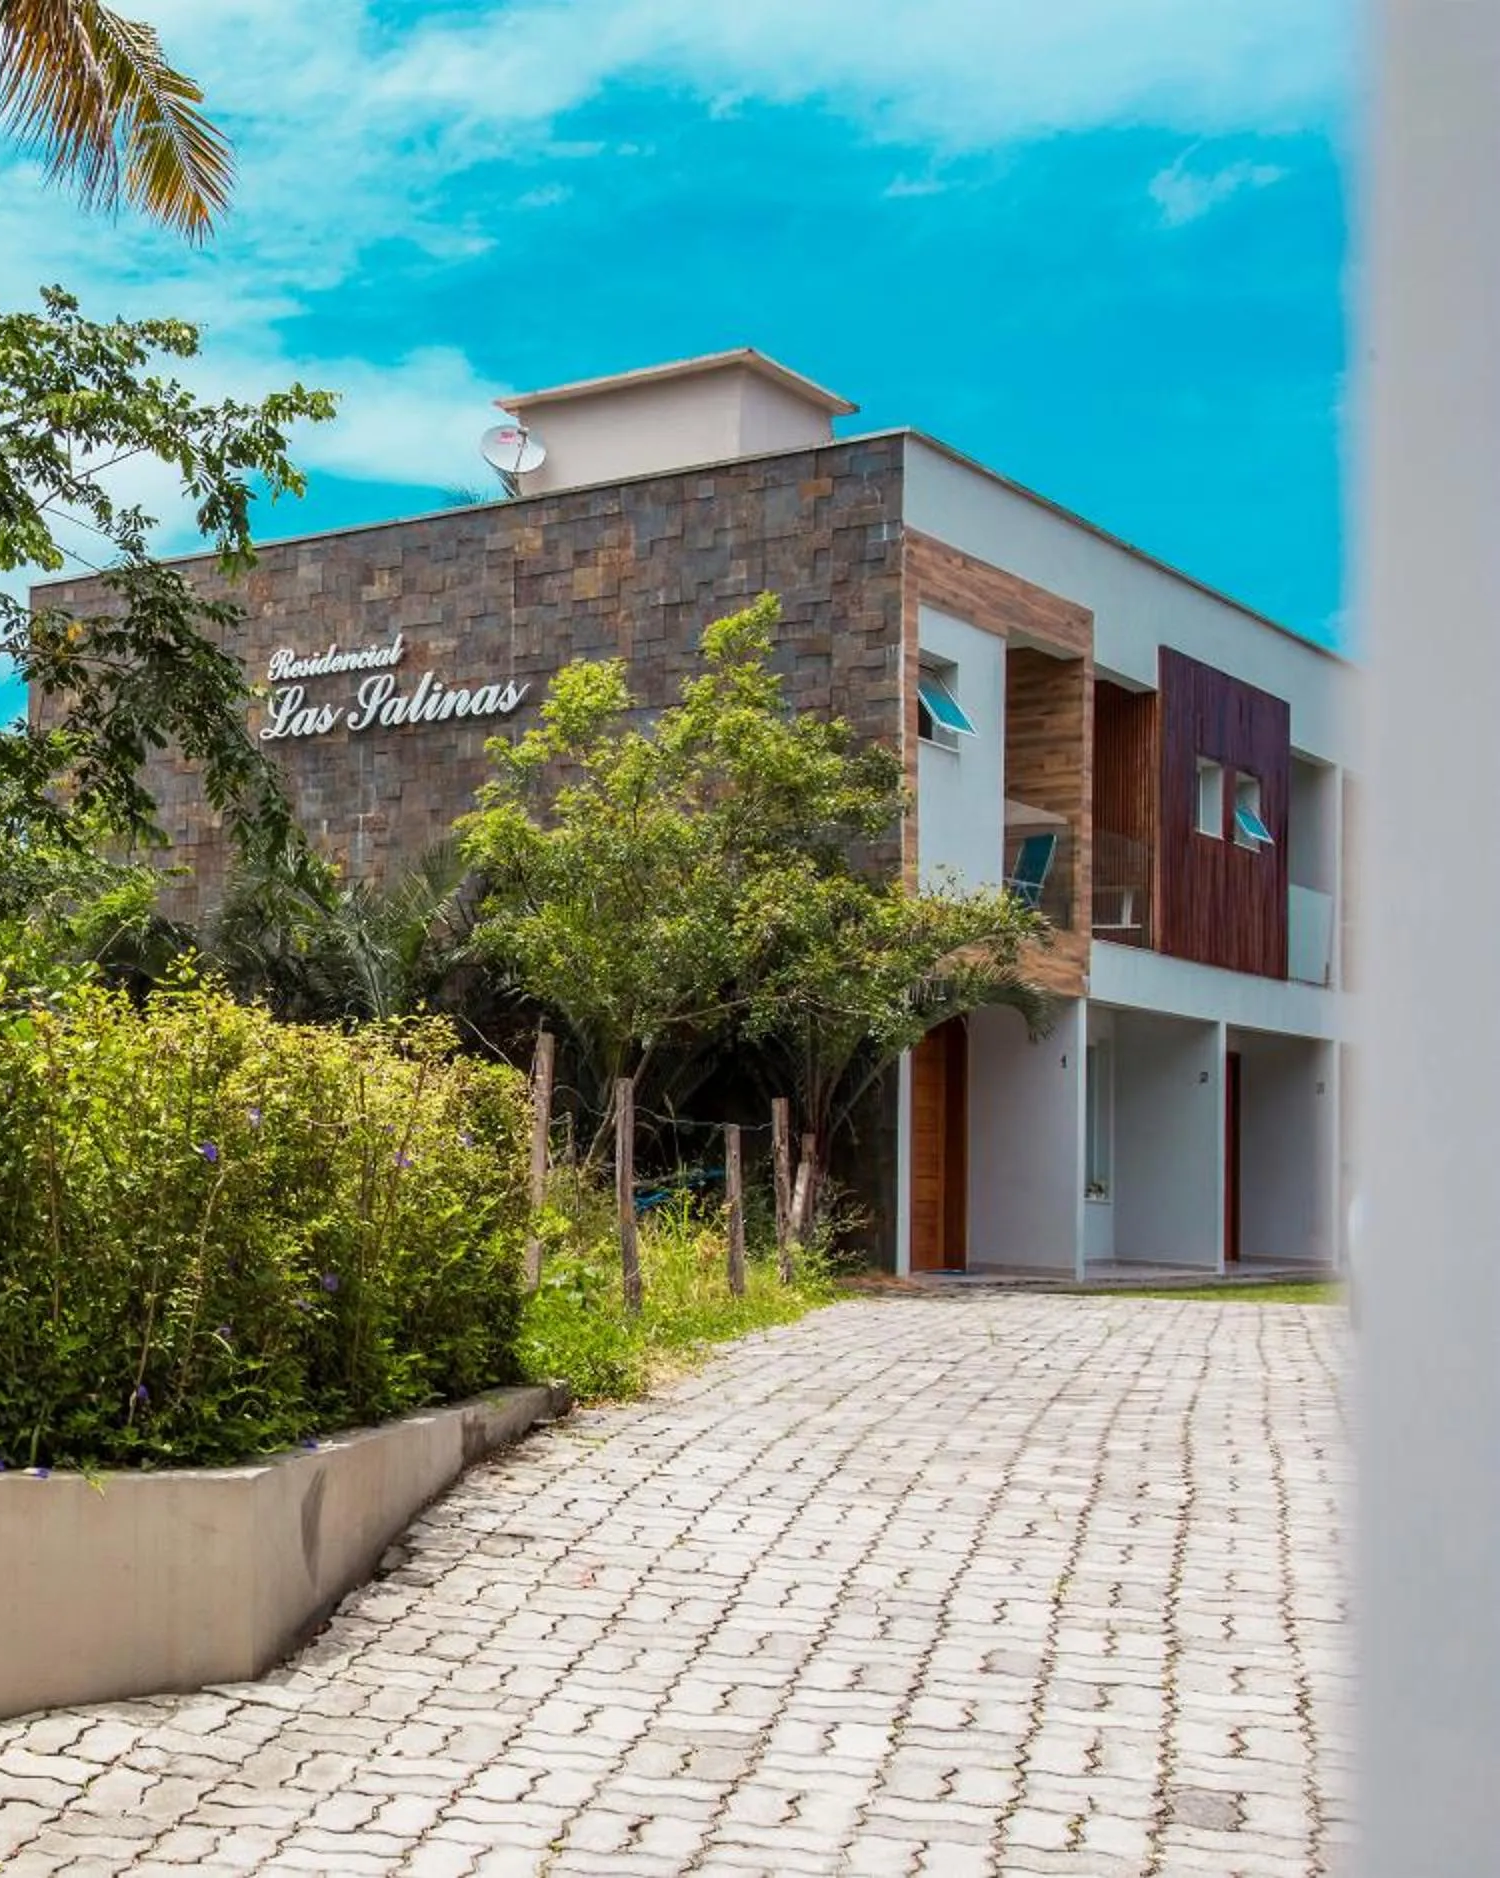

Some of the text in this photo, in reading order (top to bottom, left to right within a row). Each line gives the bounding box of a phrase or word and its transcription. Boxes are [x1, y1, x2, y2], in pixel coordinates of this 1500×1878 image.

[268, 633, 404, 681] Residencial
[260, 671, 530, 740] Las Salinas
